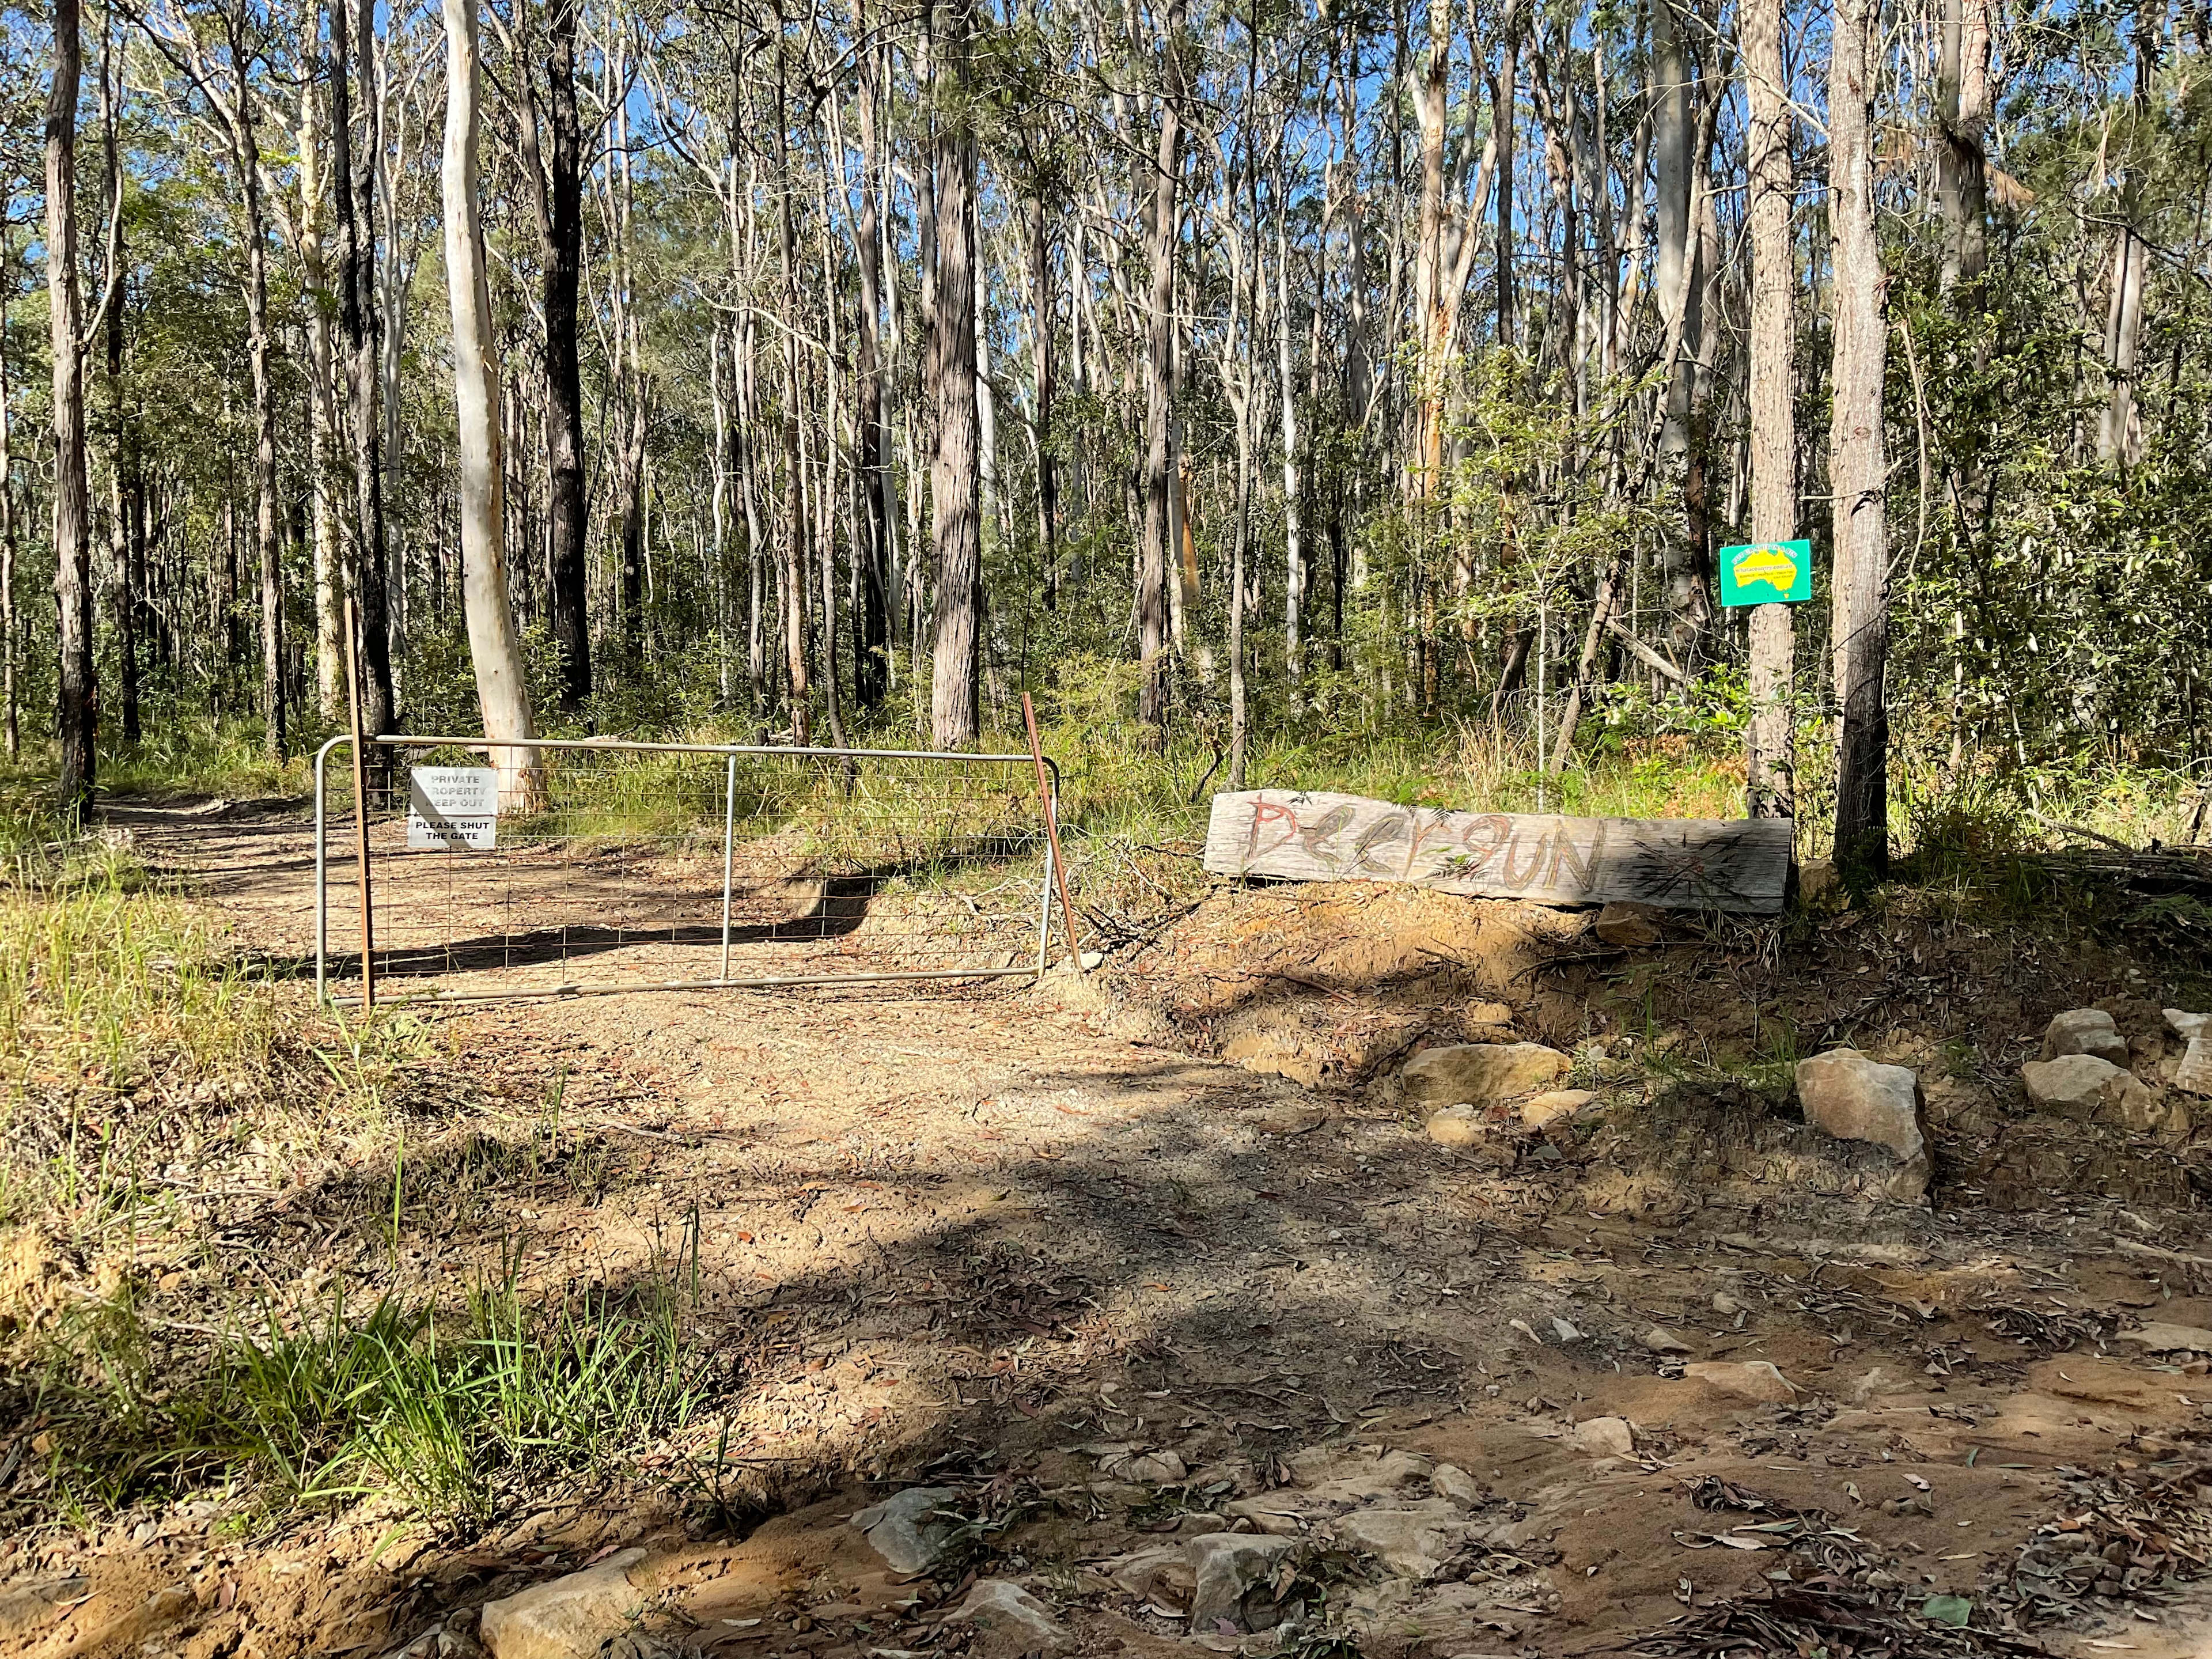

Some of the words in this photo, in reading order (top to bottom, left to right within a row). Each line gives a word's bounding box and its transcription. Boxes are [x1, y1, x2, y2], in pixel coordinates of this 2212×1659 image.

[431, 775, 480, 783] PRIVATE
[426, 787, 486, 795] ROPERTY
[460, 798, 484, 807] OUT
